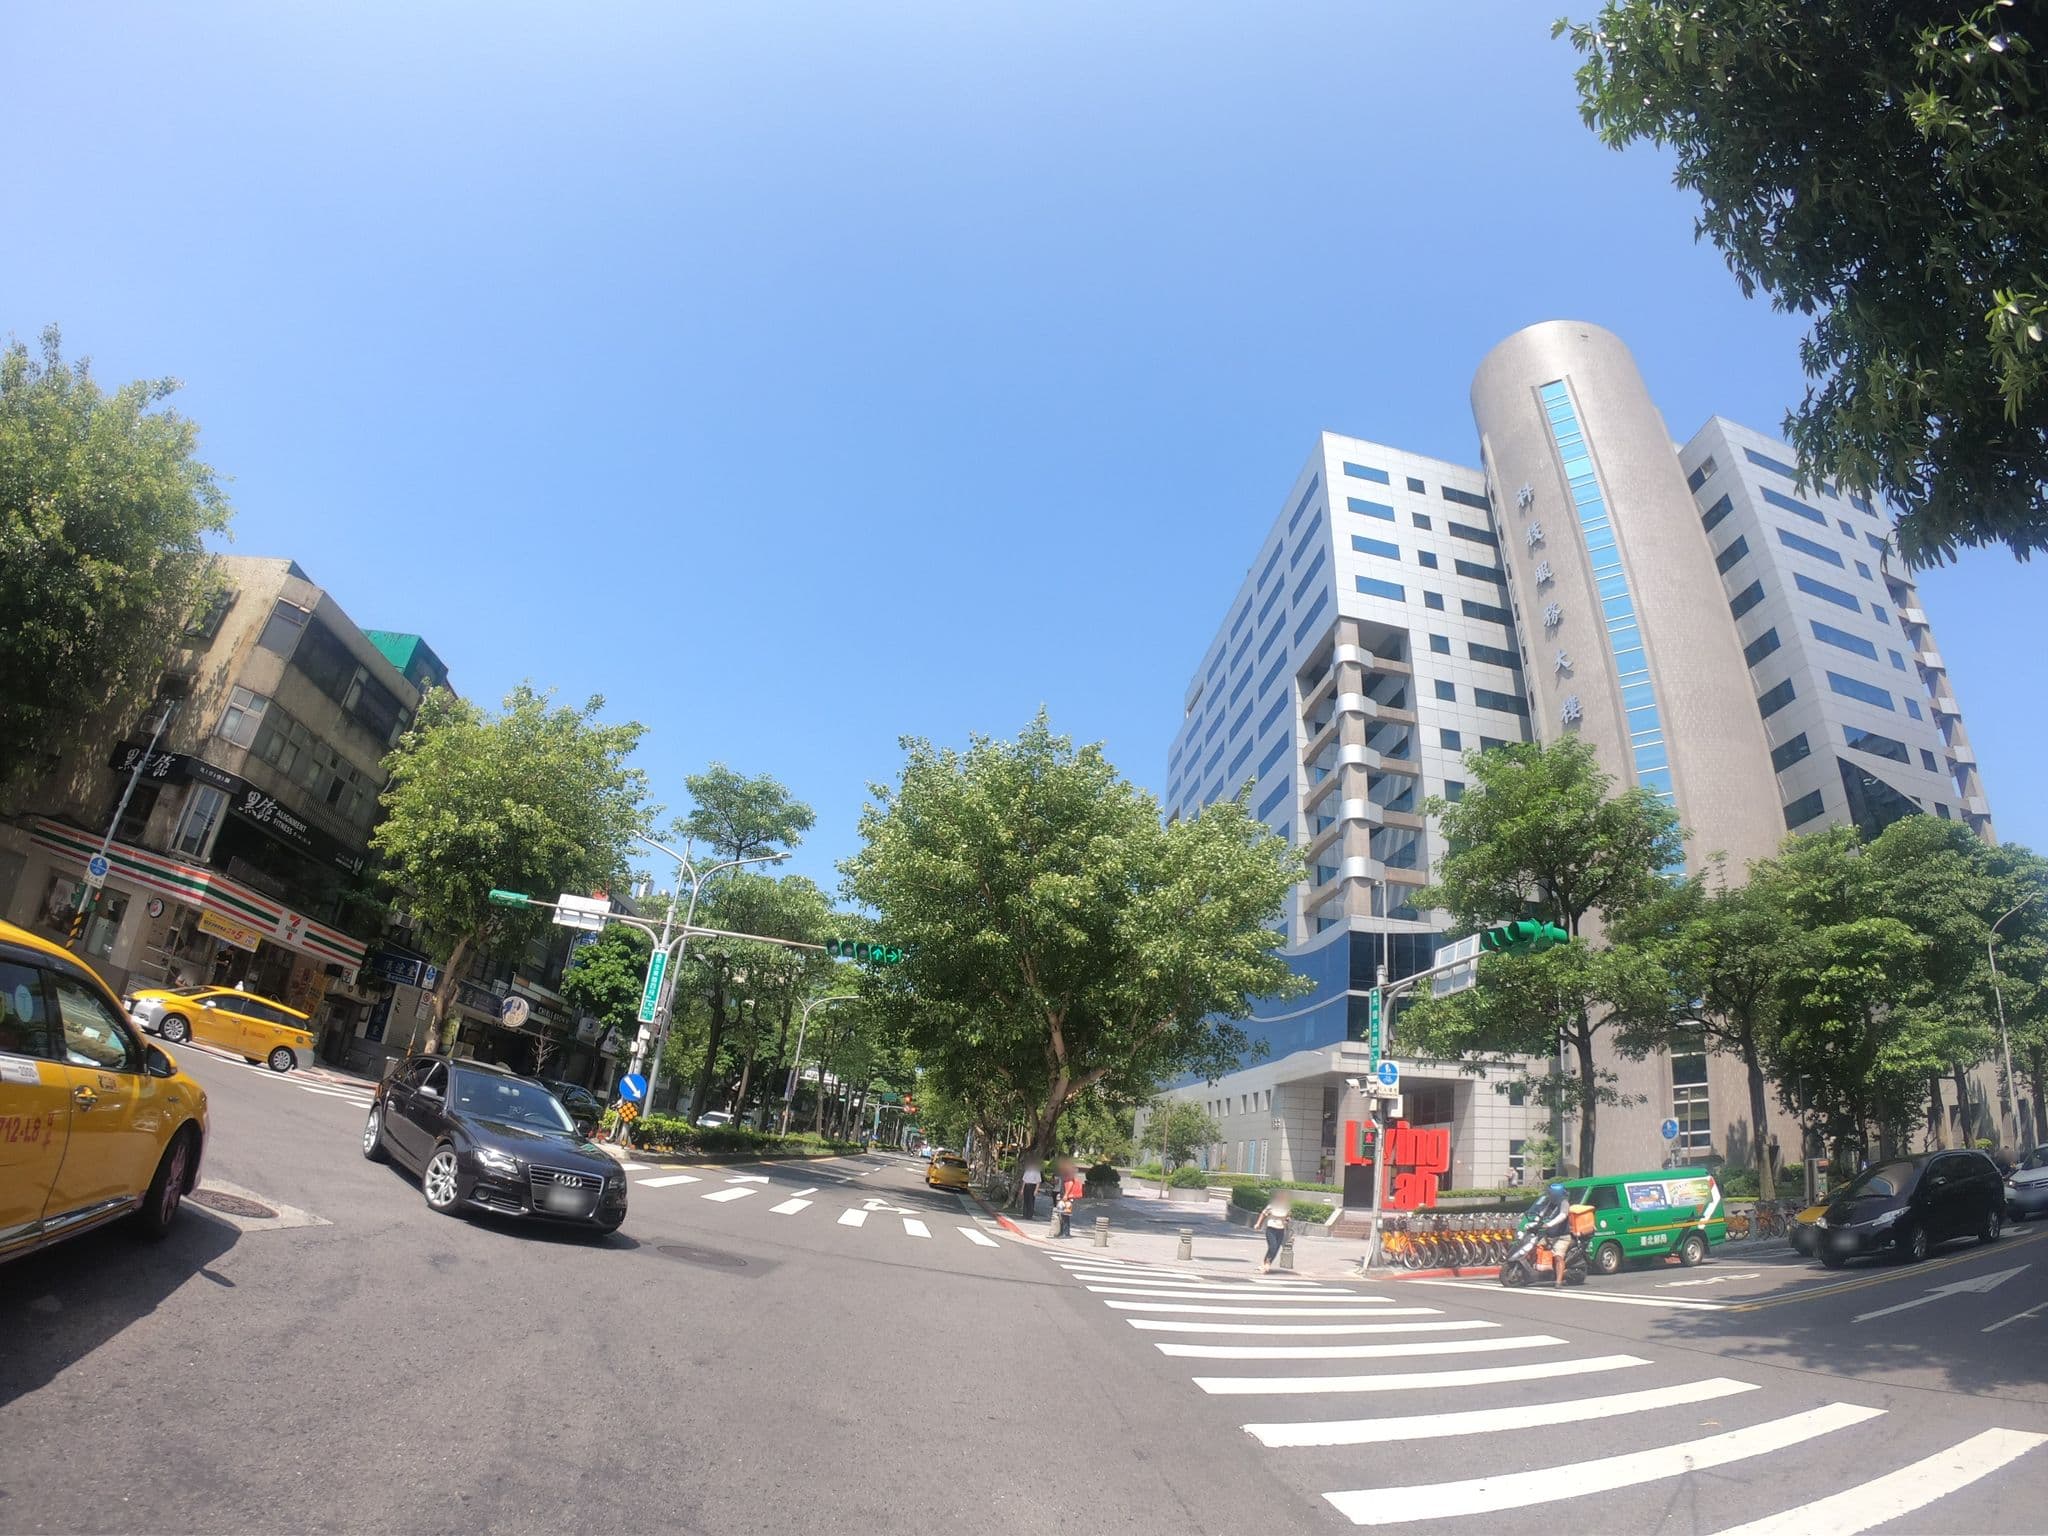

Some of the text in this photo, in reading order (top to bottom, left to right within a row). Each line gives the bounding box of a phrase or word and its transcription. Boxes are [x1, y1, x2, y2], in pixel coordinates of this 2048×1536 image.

[1517, 483, 1584, 724] 科技服務大樓
